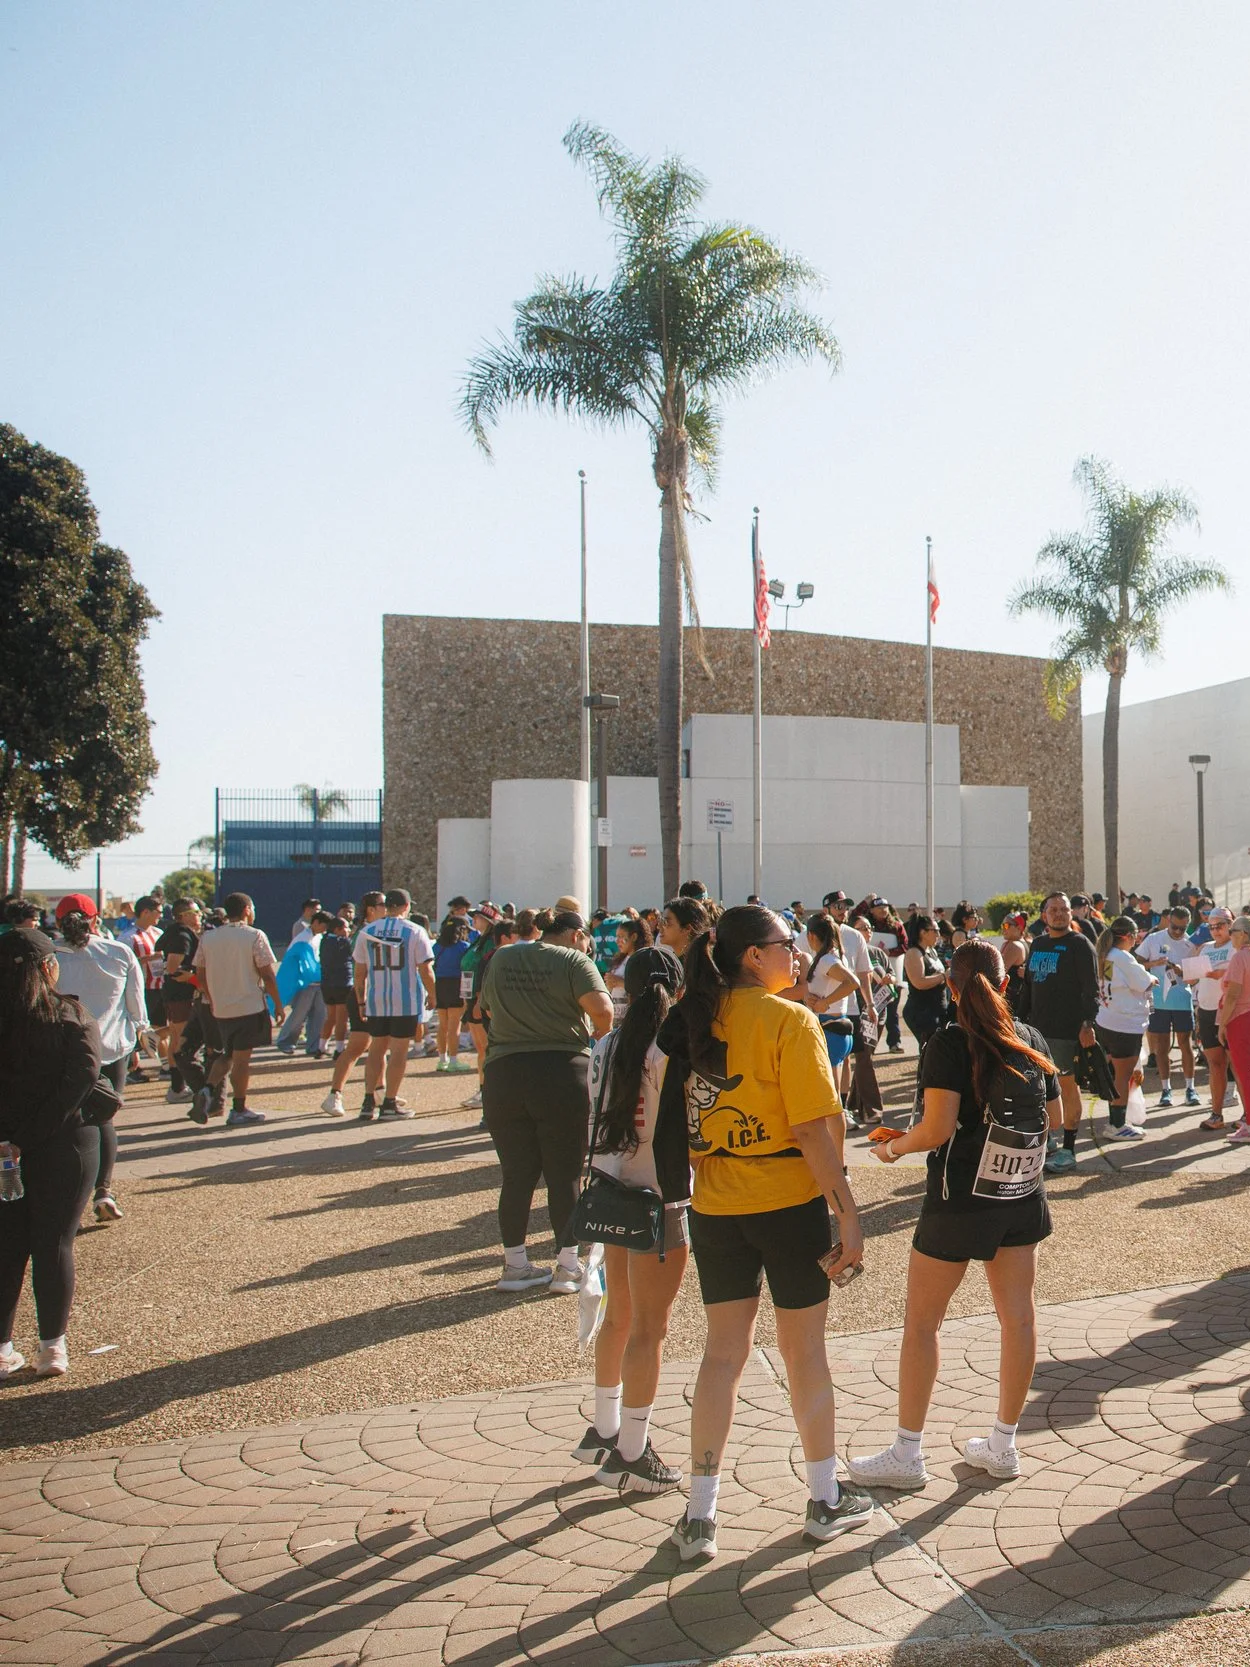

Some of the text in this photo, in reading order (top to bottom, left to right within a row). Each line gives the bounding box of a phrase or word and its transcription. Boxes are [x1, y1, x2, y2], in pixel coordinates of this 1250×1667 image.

[371, 942, 405, 971] 10
[728, 1122, 771, 1149] I.C.E.
[999, 1182, 1030, 1190] COMPTON
[585, 1222, 626, 1235] NIKE
